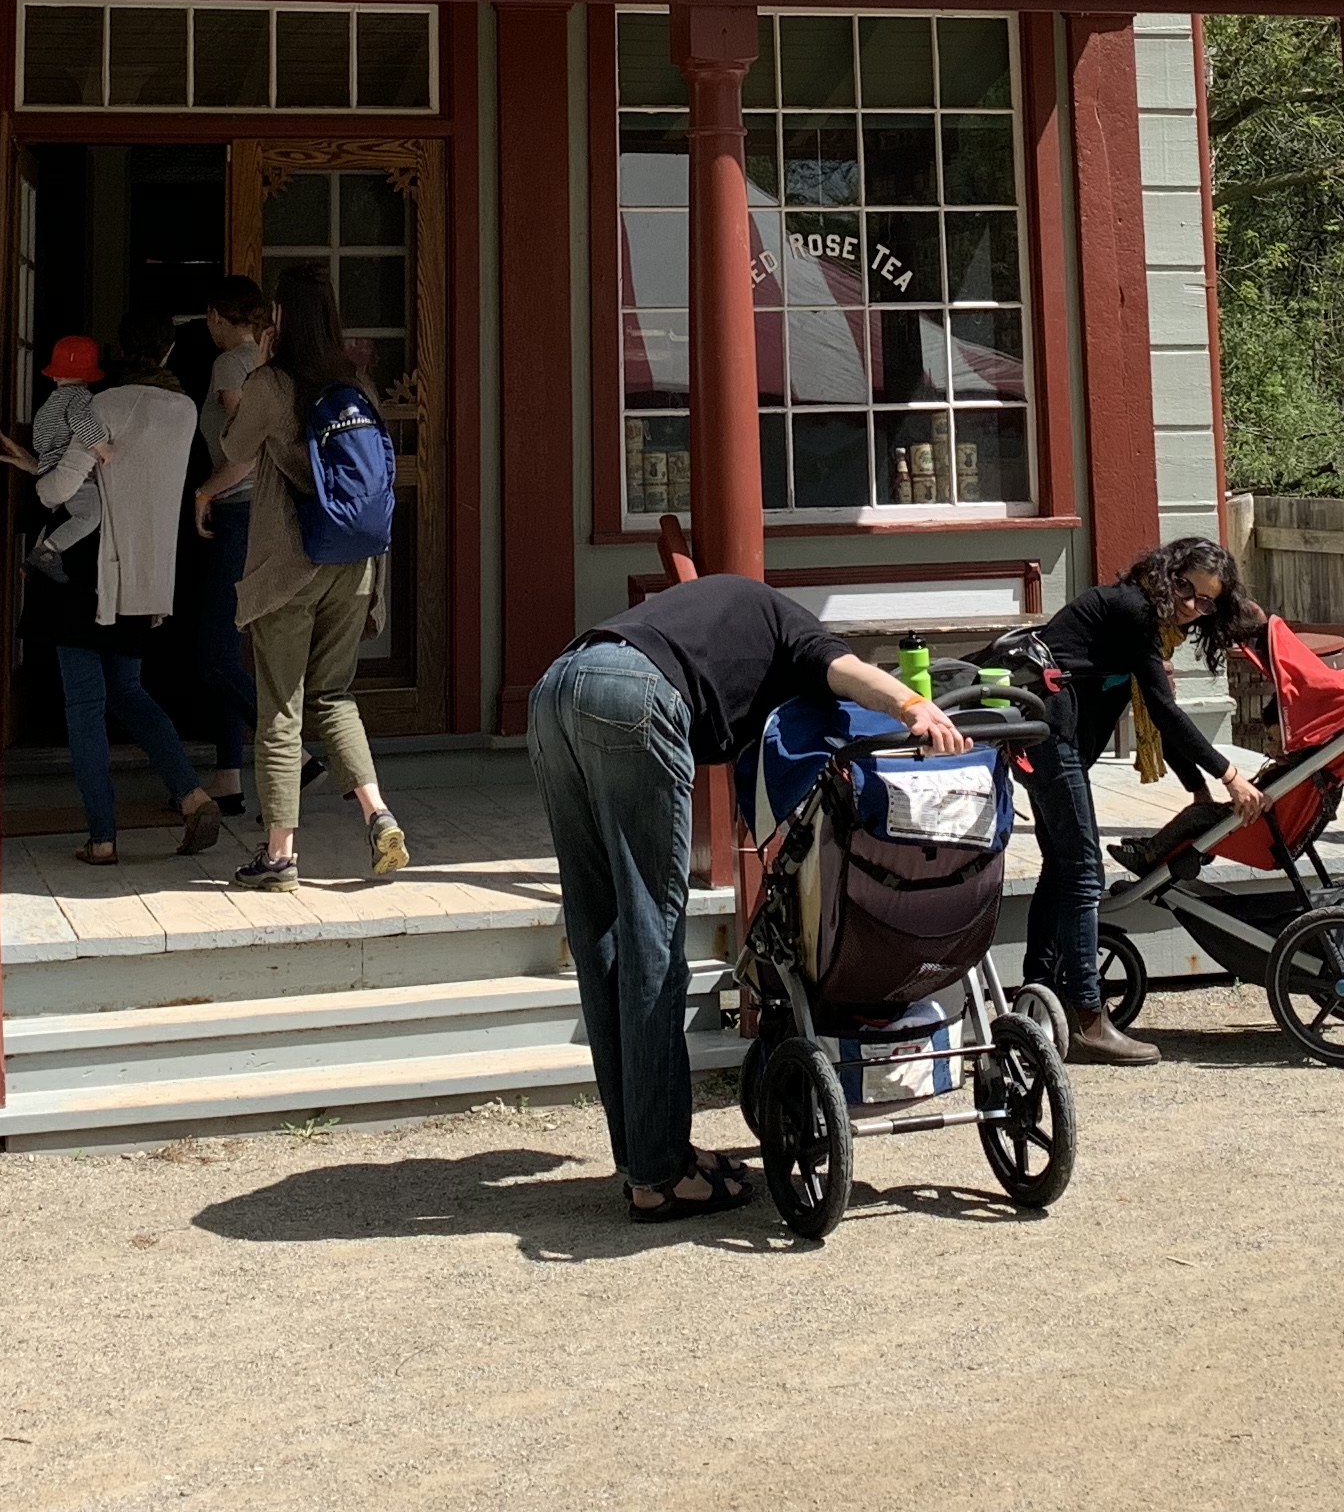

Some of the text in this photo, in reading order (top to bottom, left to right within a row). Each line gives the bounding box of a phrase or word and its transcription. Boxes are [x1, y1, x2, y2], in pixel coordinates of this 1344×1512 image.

[750, 233, 913, 293] ED ROSE TEA
